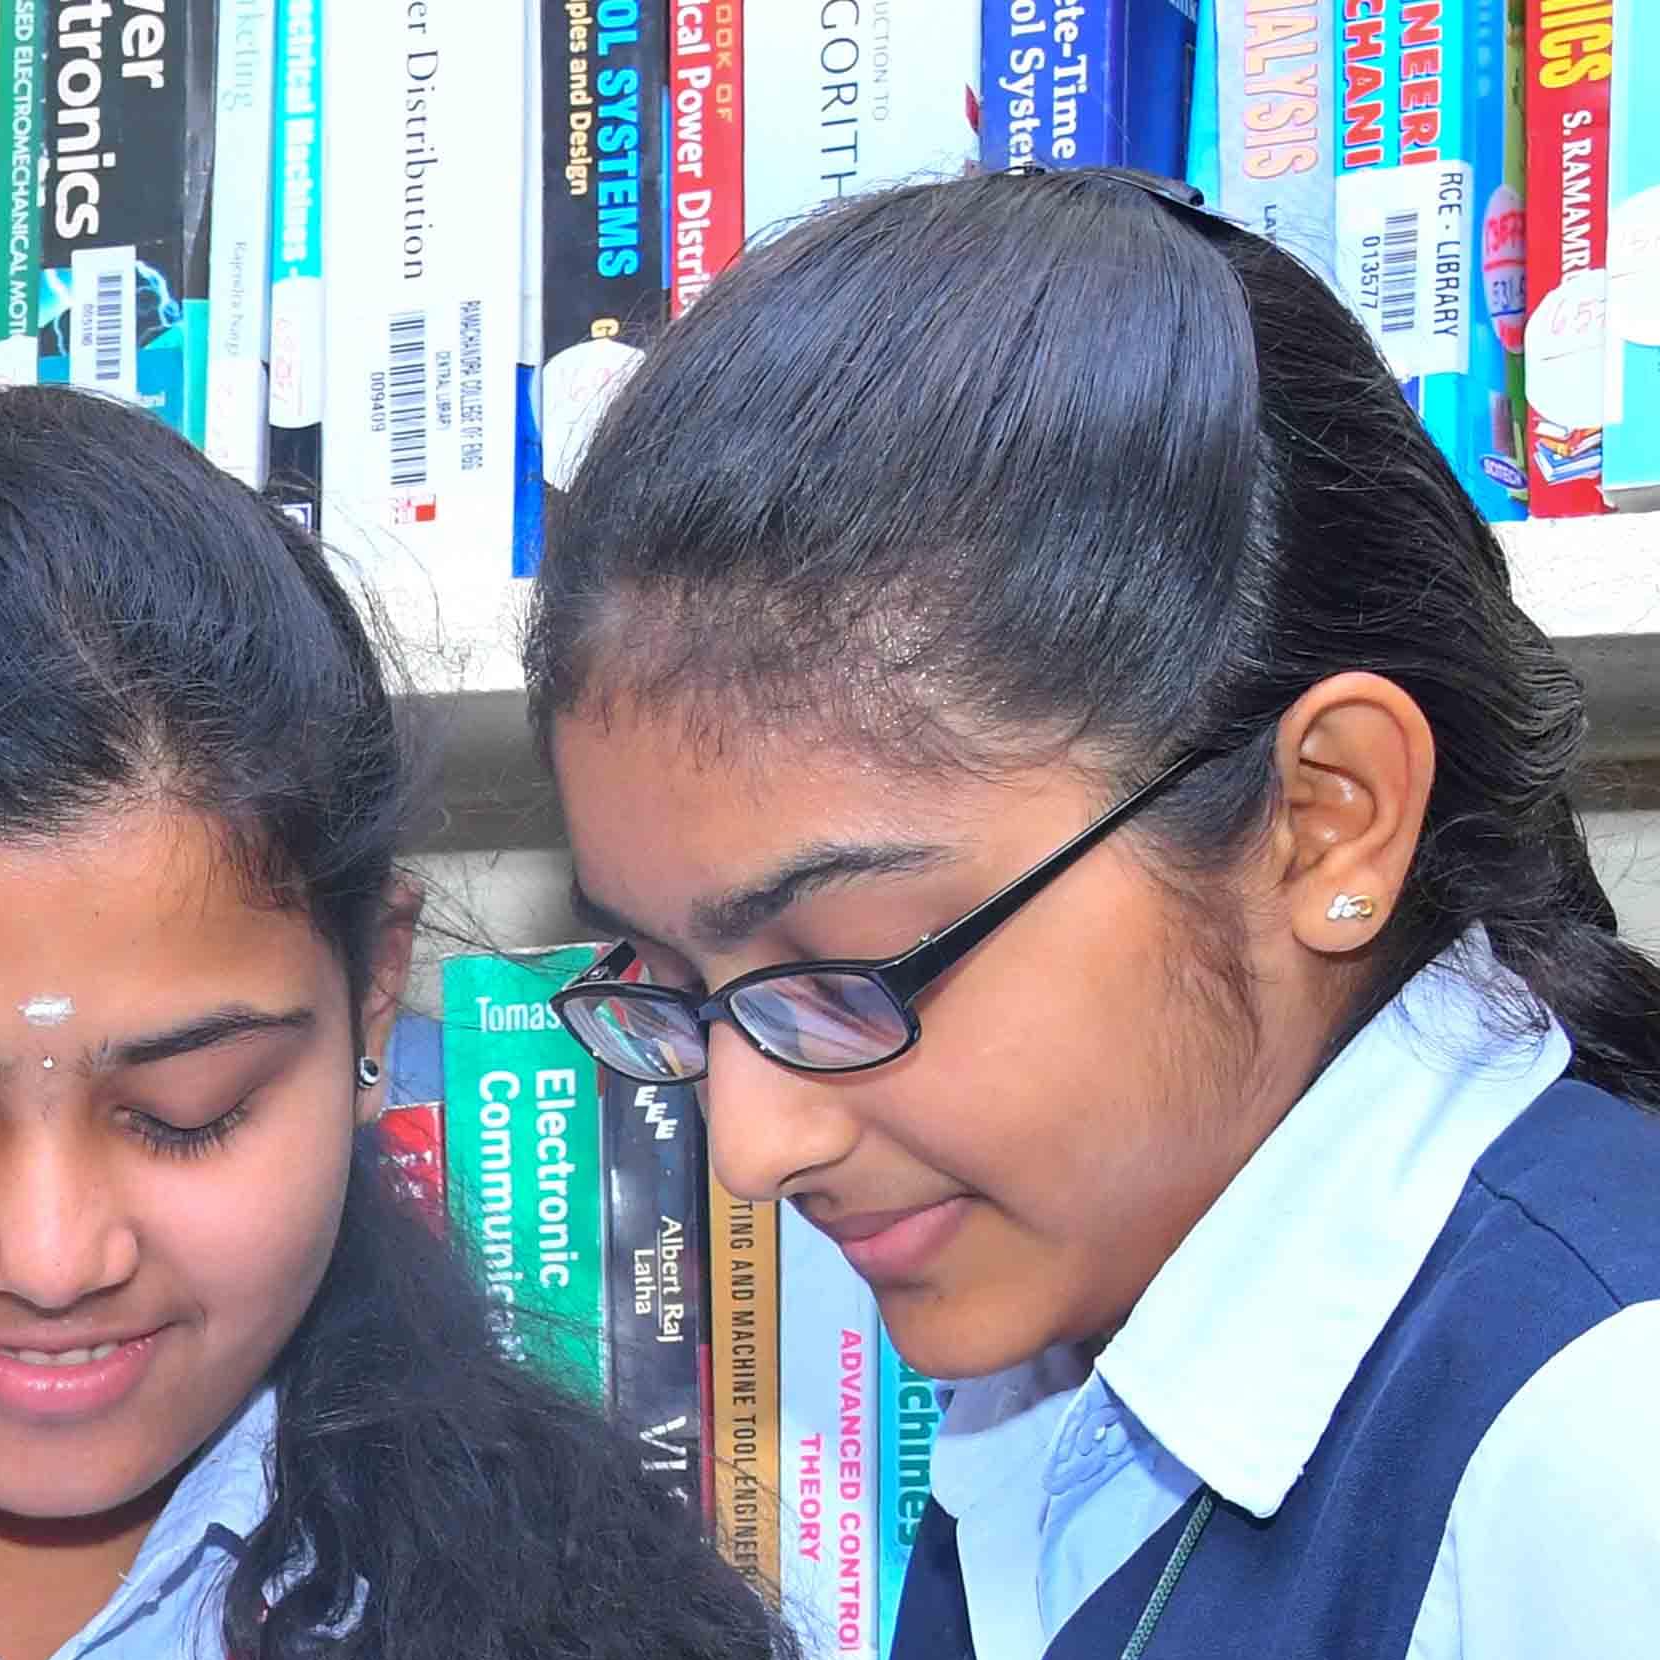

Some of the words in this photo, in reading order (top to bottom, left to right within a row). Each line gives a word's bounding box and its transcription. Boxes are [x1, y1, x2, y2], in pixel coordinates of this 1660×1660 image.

[8, 46, 33, 276] ELECTROMECHANICAL
[403, 49, 438, 280] Distribution
[597, 66, 639, 278] SYSTEMS
[676, 65, 712, 178] Power
[1361, 236, 1381, 309] 013577
[536, 1068, 576, 1289] Electronic
[634, 1249, 657, 1314] Latha
[660, 1215, 685, 1294] Albert
[656, 1304, 685, 1342] Raj
[799, 1433, 822, 1562] THEORY
